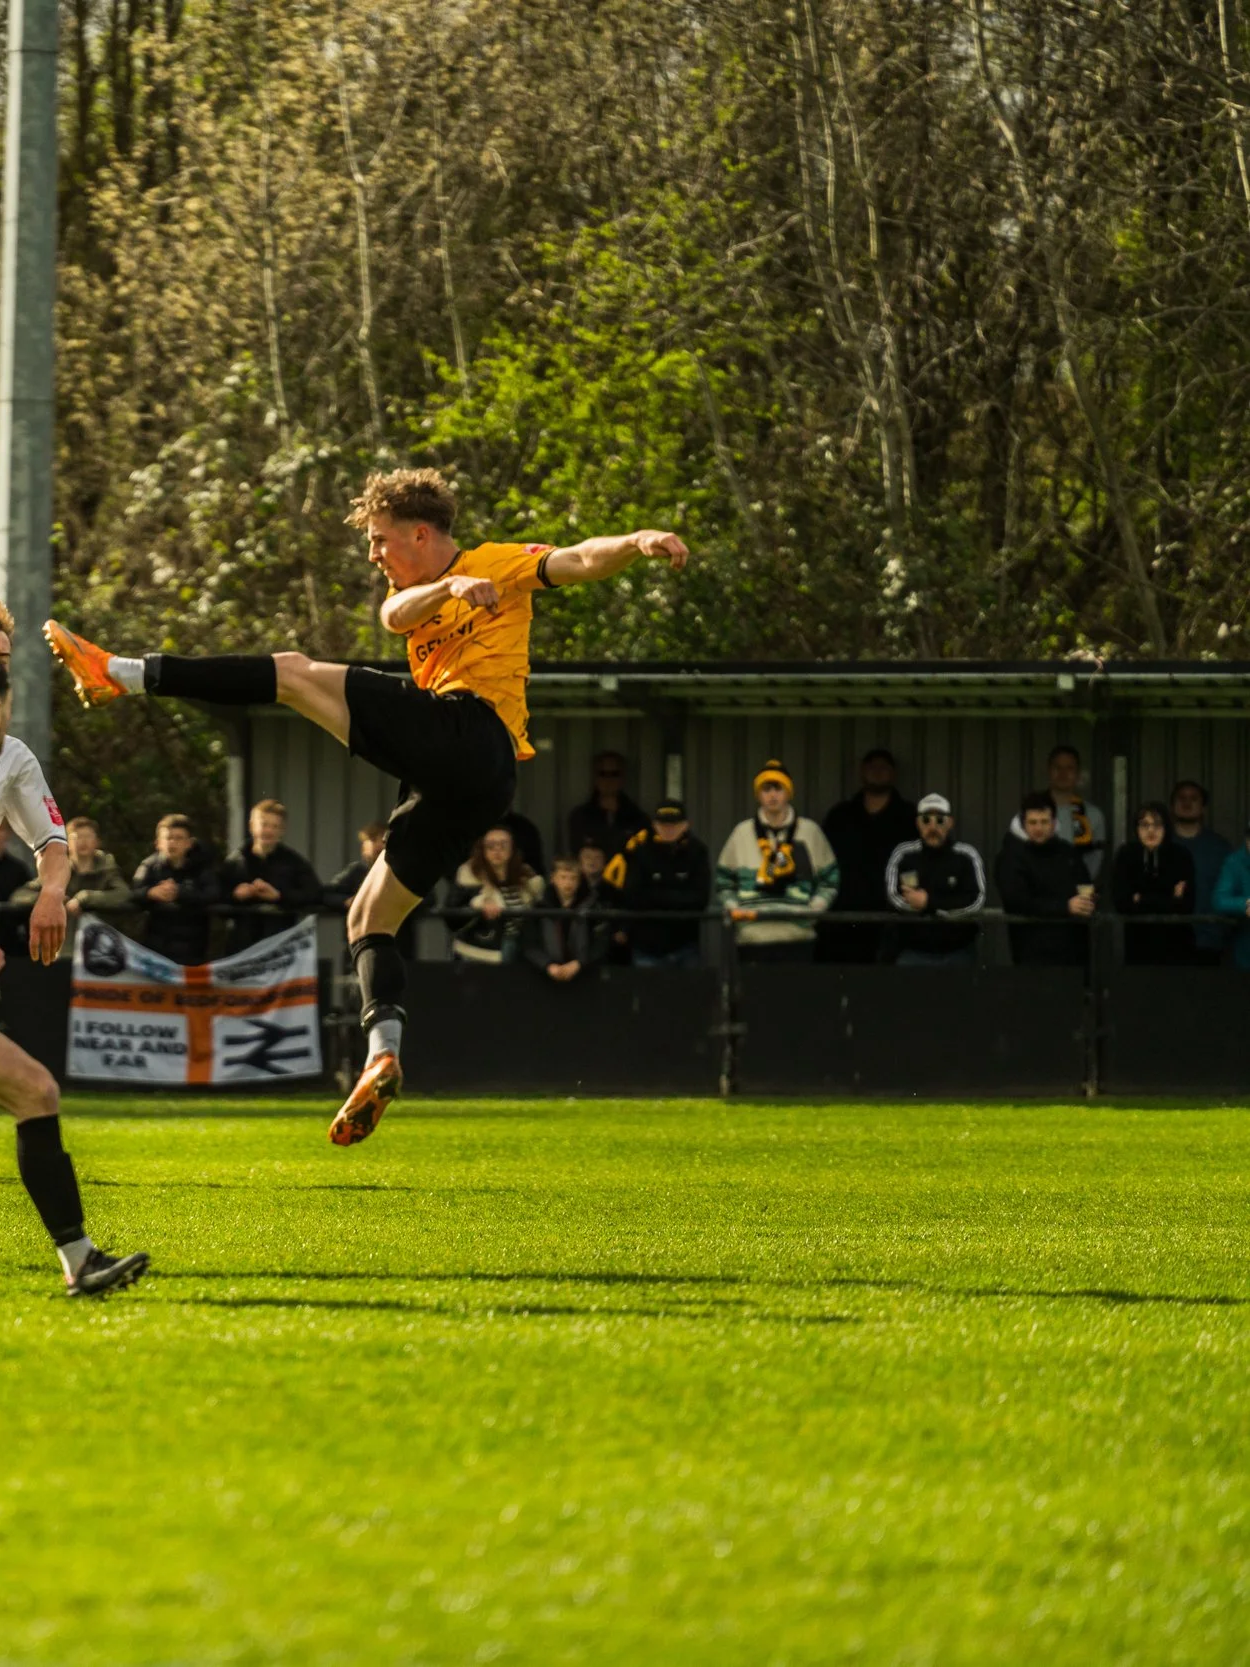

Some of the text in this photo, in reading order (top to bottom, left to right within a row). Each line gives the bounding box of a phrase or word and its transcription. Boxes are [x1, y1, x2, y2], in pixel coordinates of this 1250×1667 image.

[86, 1020, 179, 1039] FOLLOW
[74, 1036, 188, 1055] NEAR AND
[103, 1053, 147, 1068] FAR
